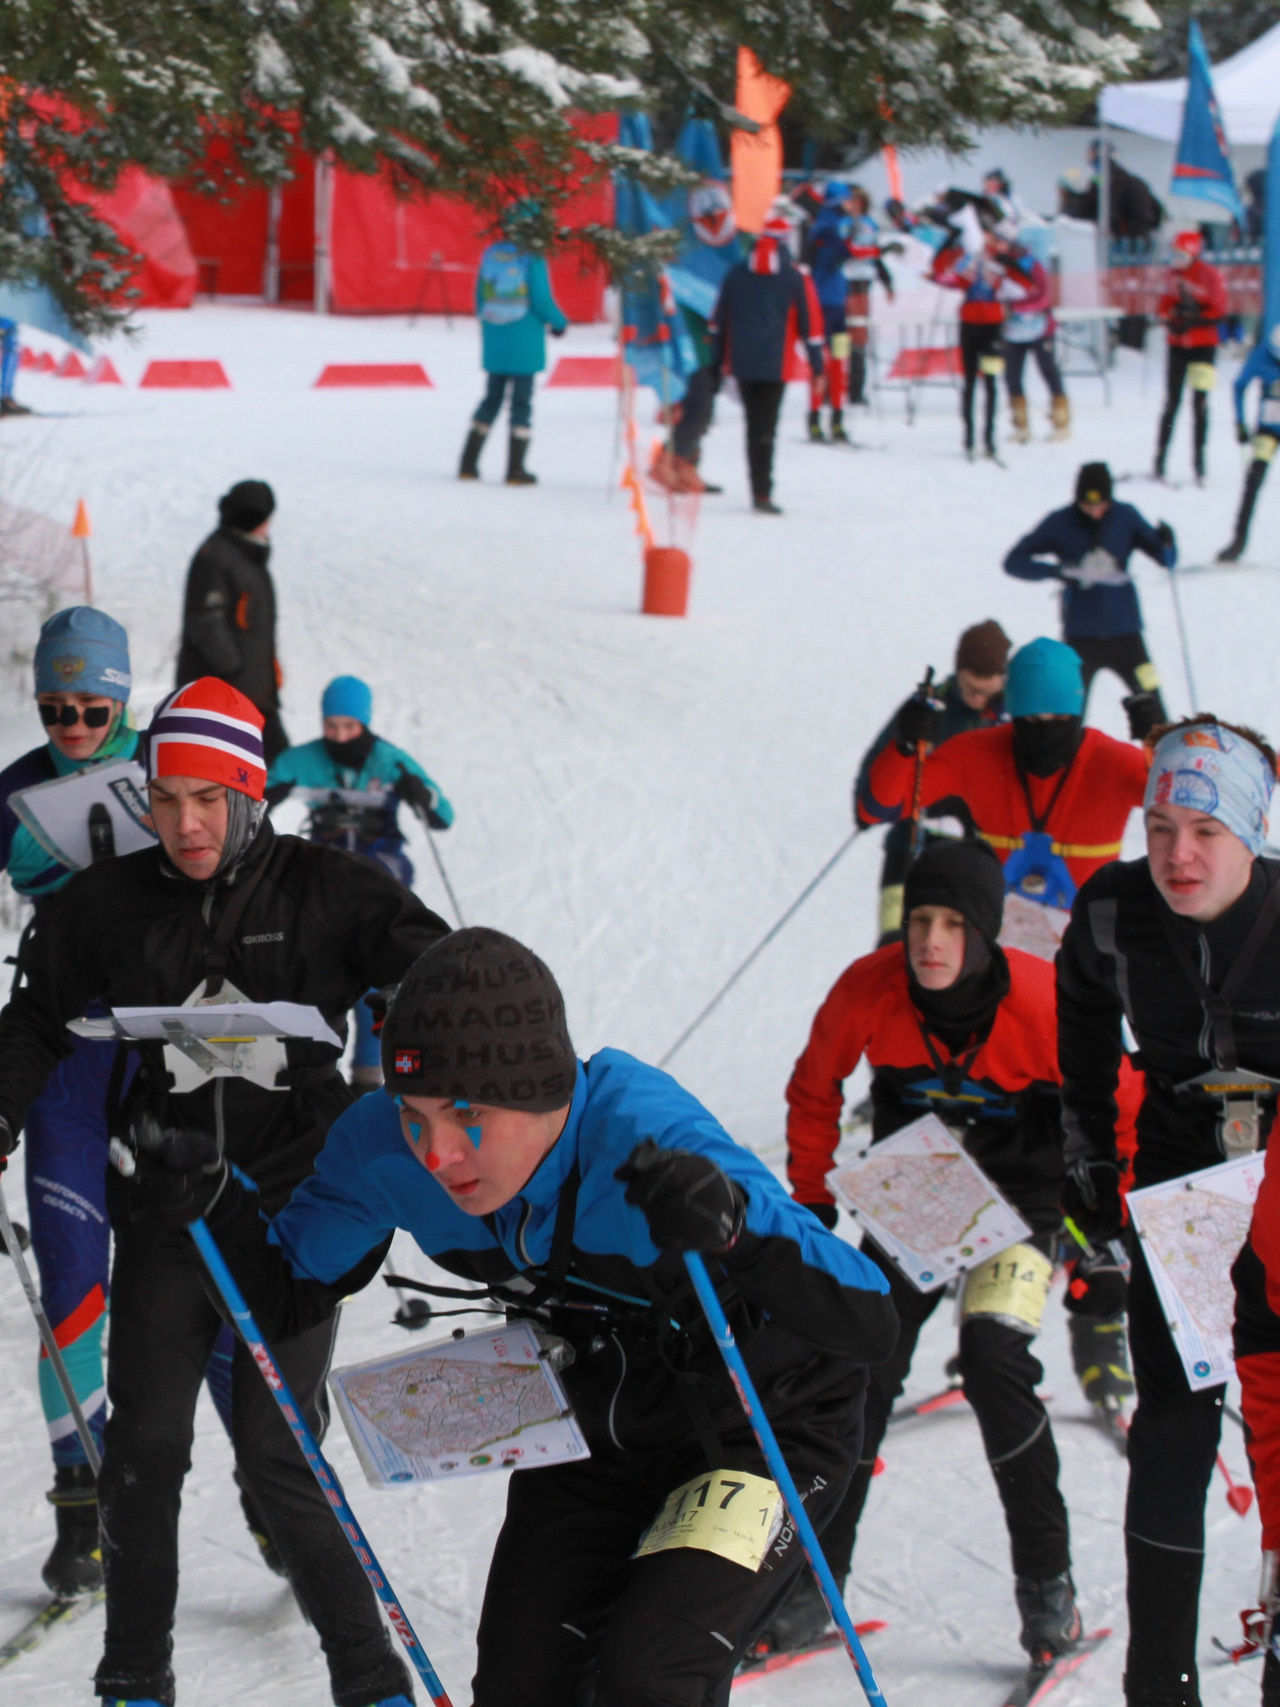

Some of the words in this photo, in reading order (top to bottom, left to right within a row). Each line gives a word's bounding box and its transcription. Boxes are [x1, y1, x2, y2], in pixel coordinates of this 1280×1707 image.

[990, 1261, 1034, 1283] 114
[280, 1404, 342, 1508] ELITE
[343, 1522, 384, 1589] PRO
[675, 1479, 746, 1517] 117
[758, 1507, 769, 1527] 1
